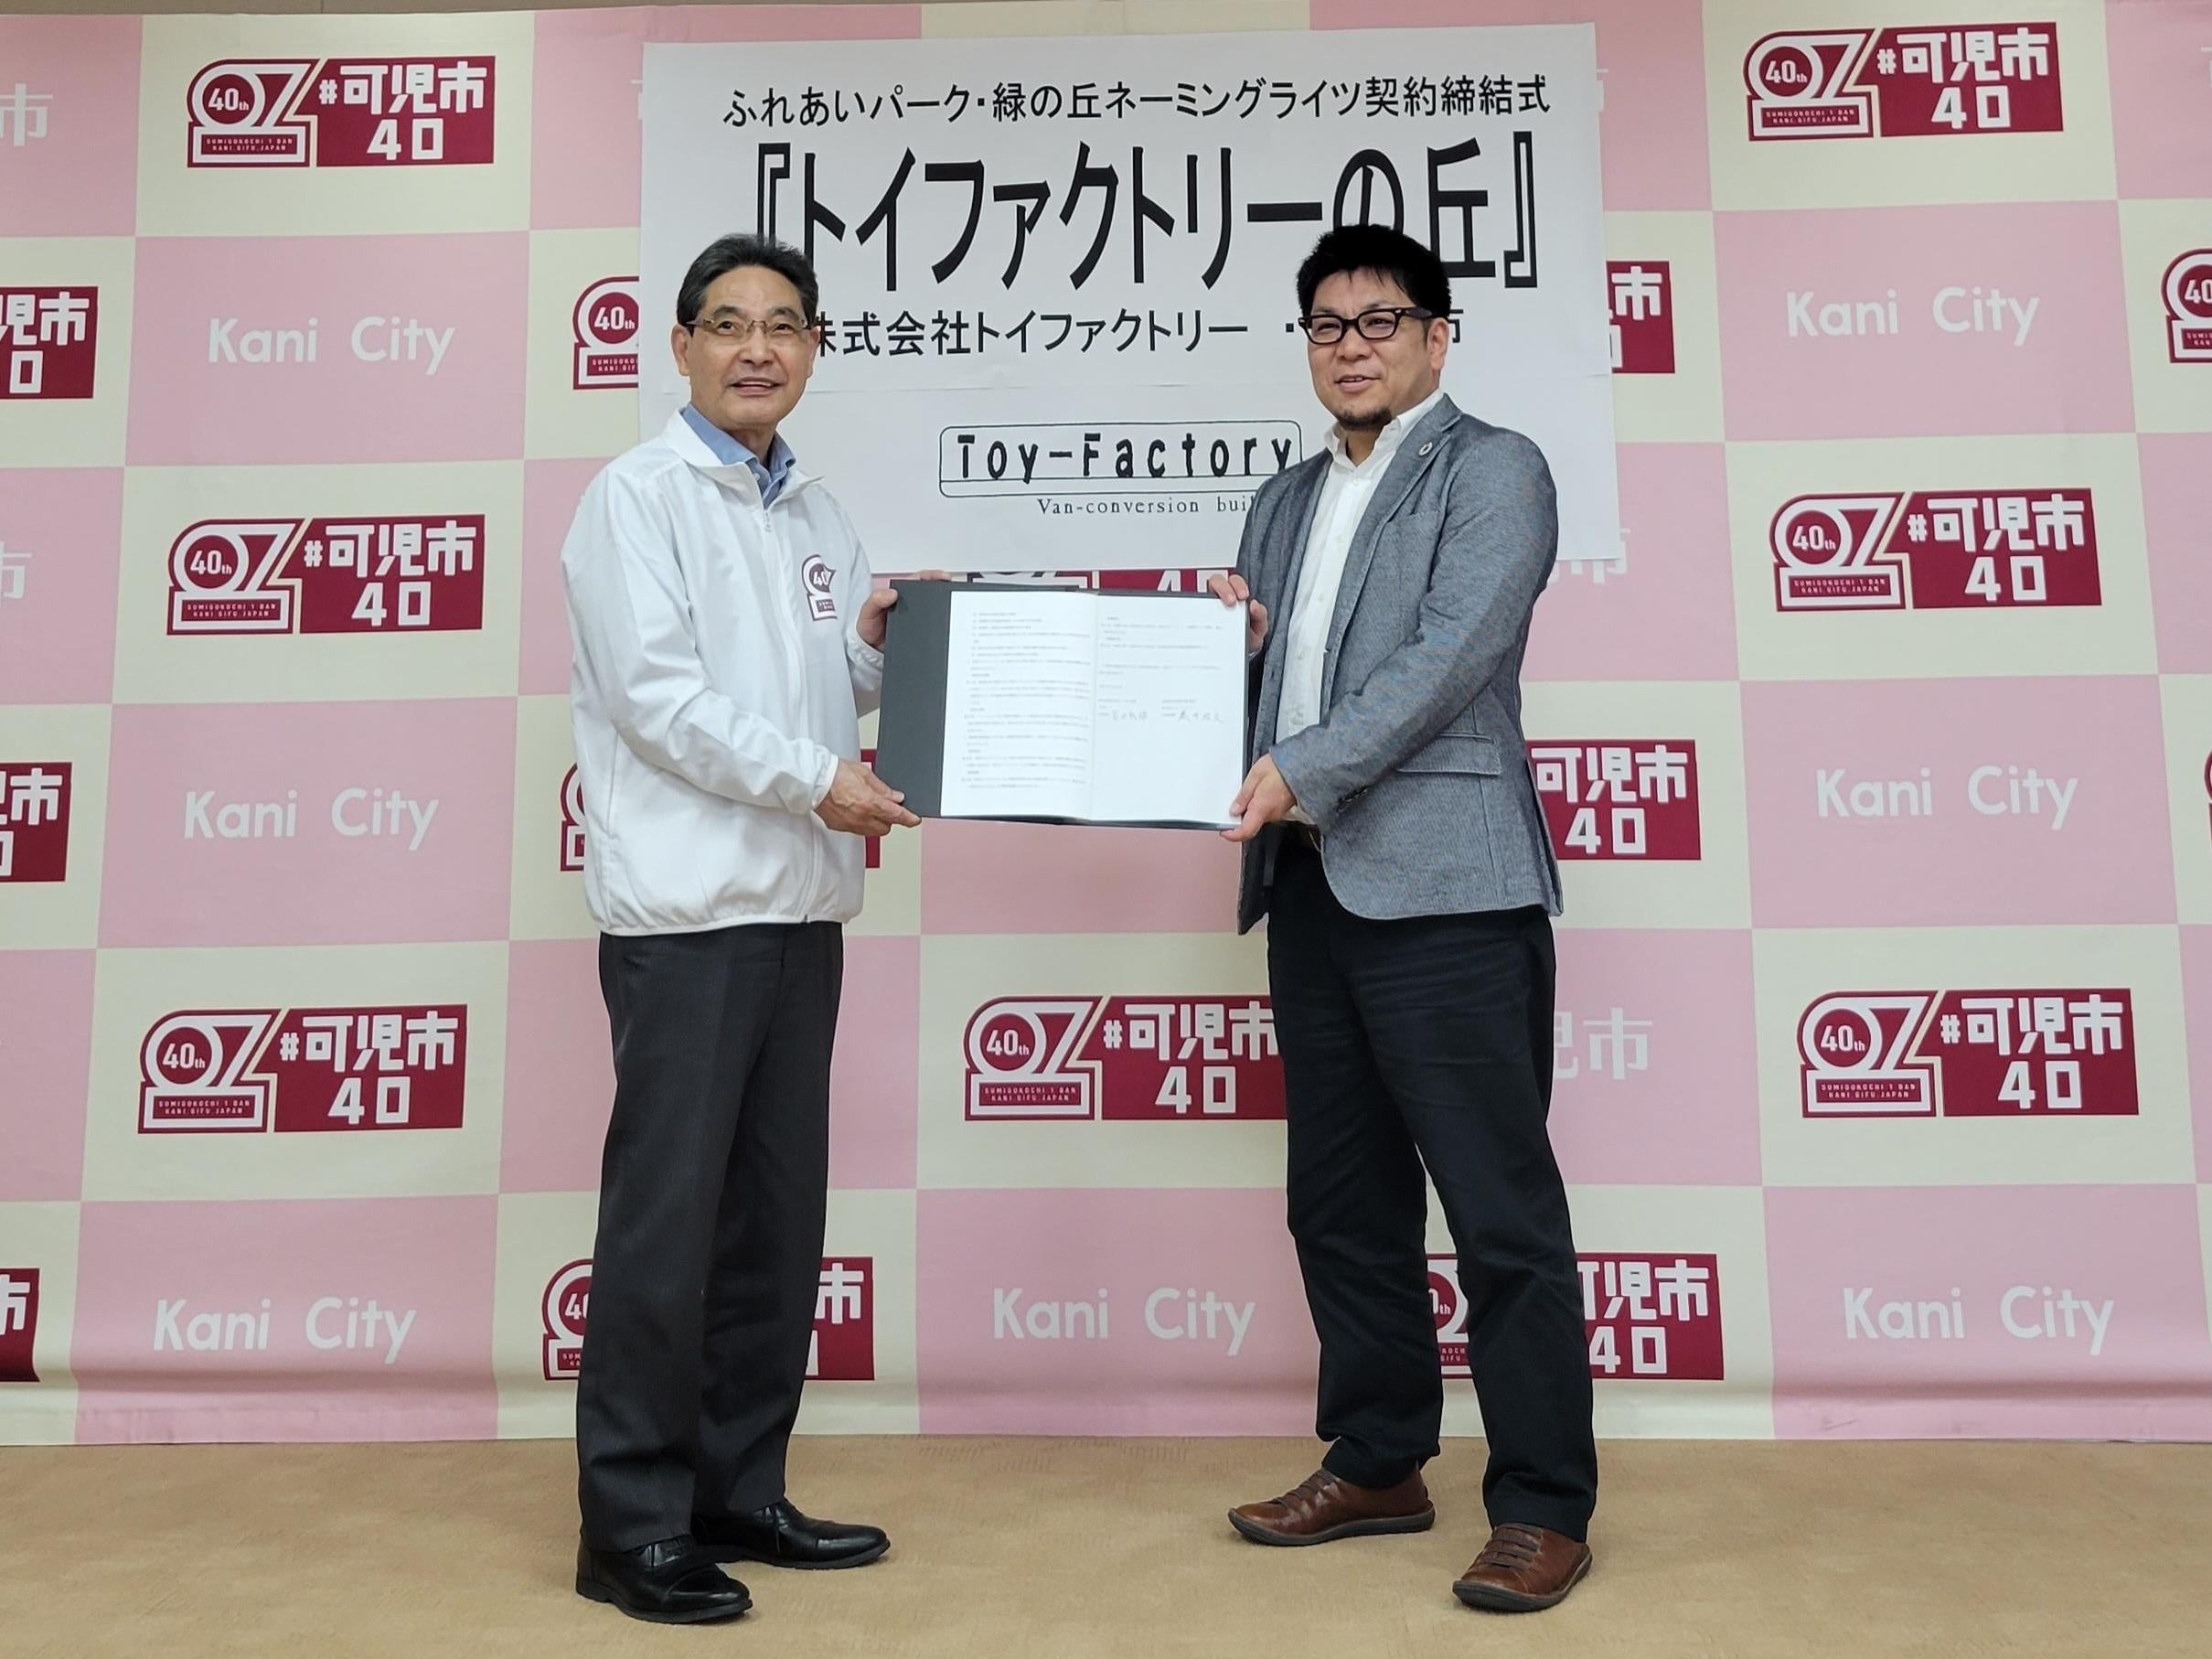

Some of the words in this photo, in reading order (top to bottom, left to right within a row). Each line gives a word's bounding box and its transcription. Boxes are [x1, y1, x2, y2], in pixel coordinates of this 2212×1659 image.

[1765, 60, 1807, 84] 40th
[208, 88, 249, 112] 40th
[722, 73, 1552, 127] ふれあいパーク・緑の丘ネーミングライツ契約締結式
[1931, 85, 2011, 129] 40
[367, 118, 443, 160] 40
[594, 306, 635, 330] 40th
[1786, 289, 1899, 337] Kani
[1932, 286, 2040, 346] City
[207, 316, 318, 363] Kani
[350, 316, 456, 375] City
[956, 432, 1292, 485] Toy-Factory
[1036, 497, 1200, 515] Van-conversion
[1792, 525, 1835, 551] 40th
[190, 550, 231, 574] 40th
[1964, 555, 2046, 602] 40
[352, 582, 431, 626] 40
[183, 789, 297, 839] Kani
[331, 787, 440, 851] City
[1815, 767, 1932, 818] Kani
[1967, 765, 2078, 830] City
[1565, 808, 1647, 854] 40
[162, 1044, 205, 1068] 40th
[986, 1029, 1029, 1055] 40th
[1821, 1024, 1865, 1052] 40th
[327, 1076, 411, 1124] 40
[1155, 1066, 1235, 1113] 40
[1998, 1060, 2082, 1109] 40
[153, 1298, 271, 1351] Kani
[305, 1296, 416, 1365] City
[993, 1288, 1108, 1340] Kani
[1144, 1287, 1256, 1356] City
[1843, 1287, 1963, 1340] Kani
[2001, 1286, 2114, 1355] City
[1589, 1326, 1668, 1375] 40
